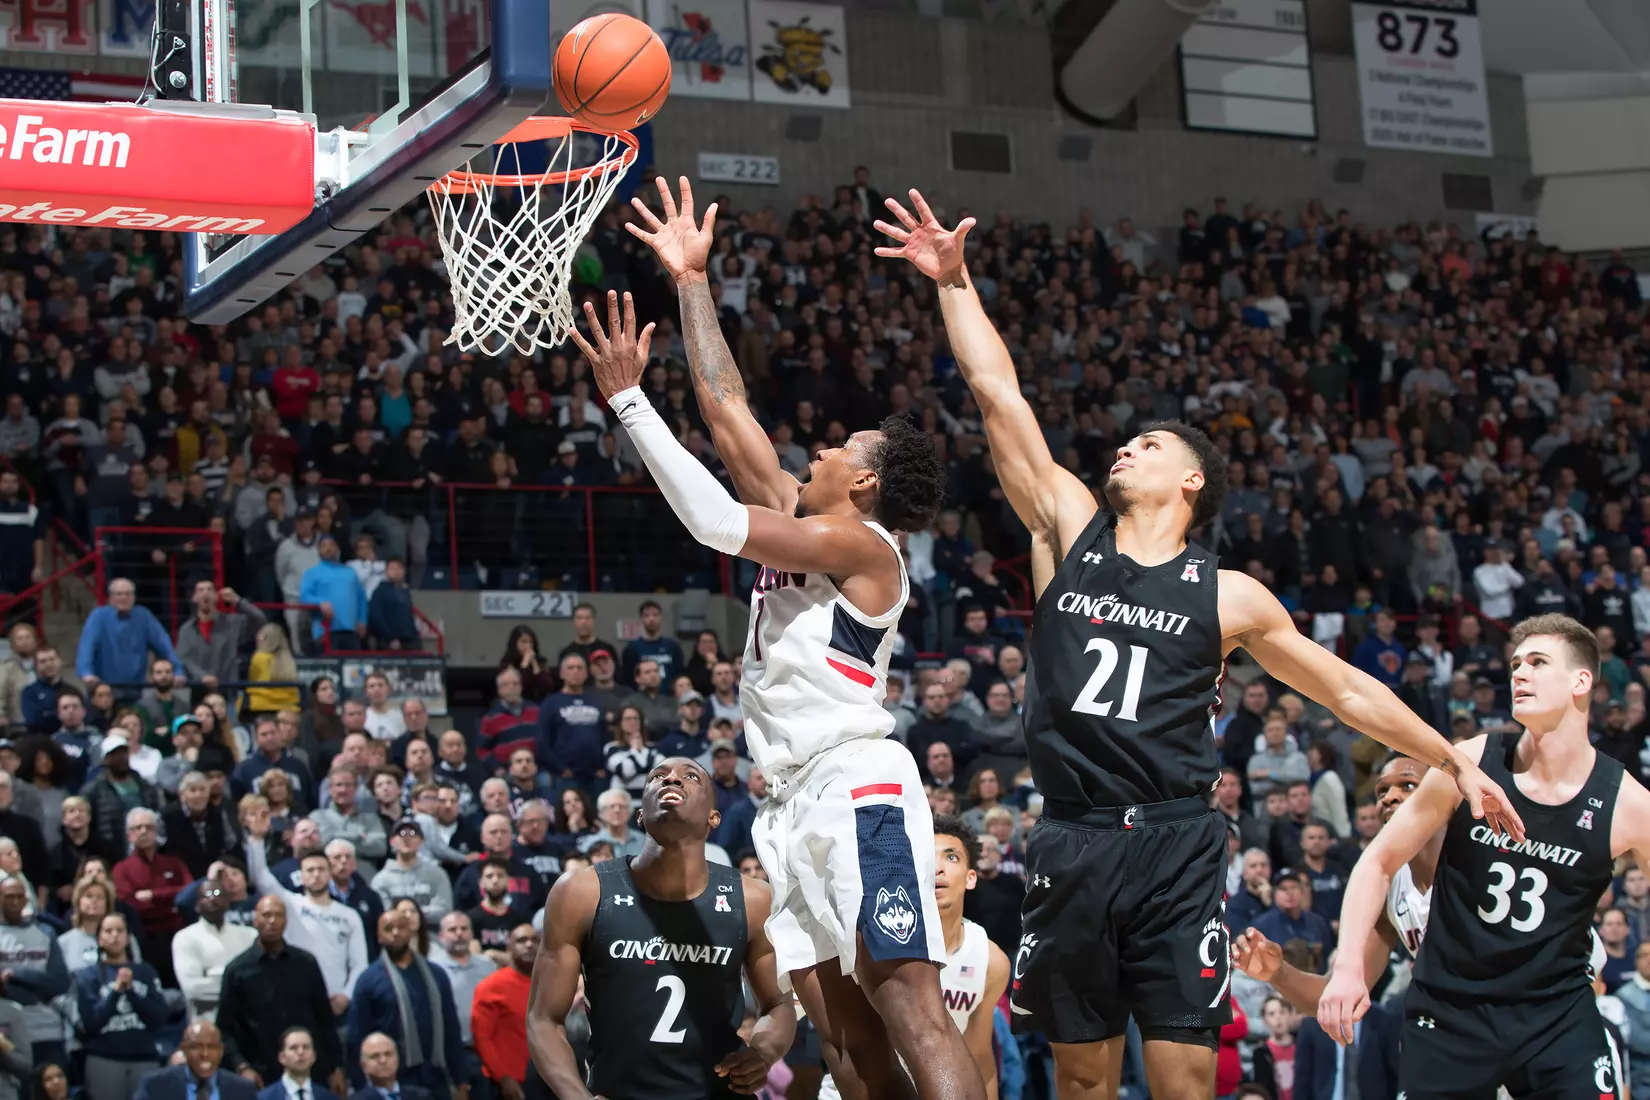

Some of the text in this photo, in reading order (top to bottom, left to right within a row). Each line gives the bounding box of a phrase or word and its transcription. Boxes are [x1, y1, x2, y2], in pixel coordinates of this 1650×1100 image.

[660, 26, 747, 67] Tulsa
[1376, 11, 1459, 59] 873
[9, 113, 131, 168] Farm
[701, 159, 777, 179] SEC 222
[81, 204, 266, 232] Farm
[484, 596, 515, 612] SEC
[1057, 591, 1191, 636] CINCINNATI
[1071, 637, 1149, 723] 21
[1588, 797, 1603, 809] CM
[1469, 824, 1583, 867] CINCINNATI
[717, 885, 734, 893] CM
[1477, 861, 1549, 933] 33
[609, 938, 734, 966] CINCINNATI
[649, 974, 687, 1044] 2
